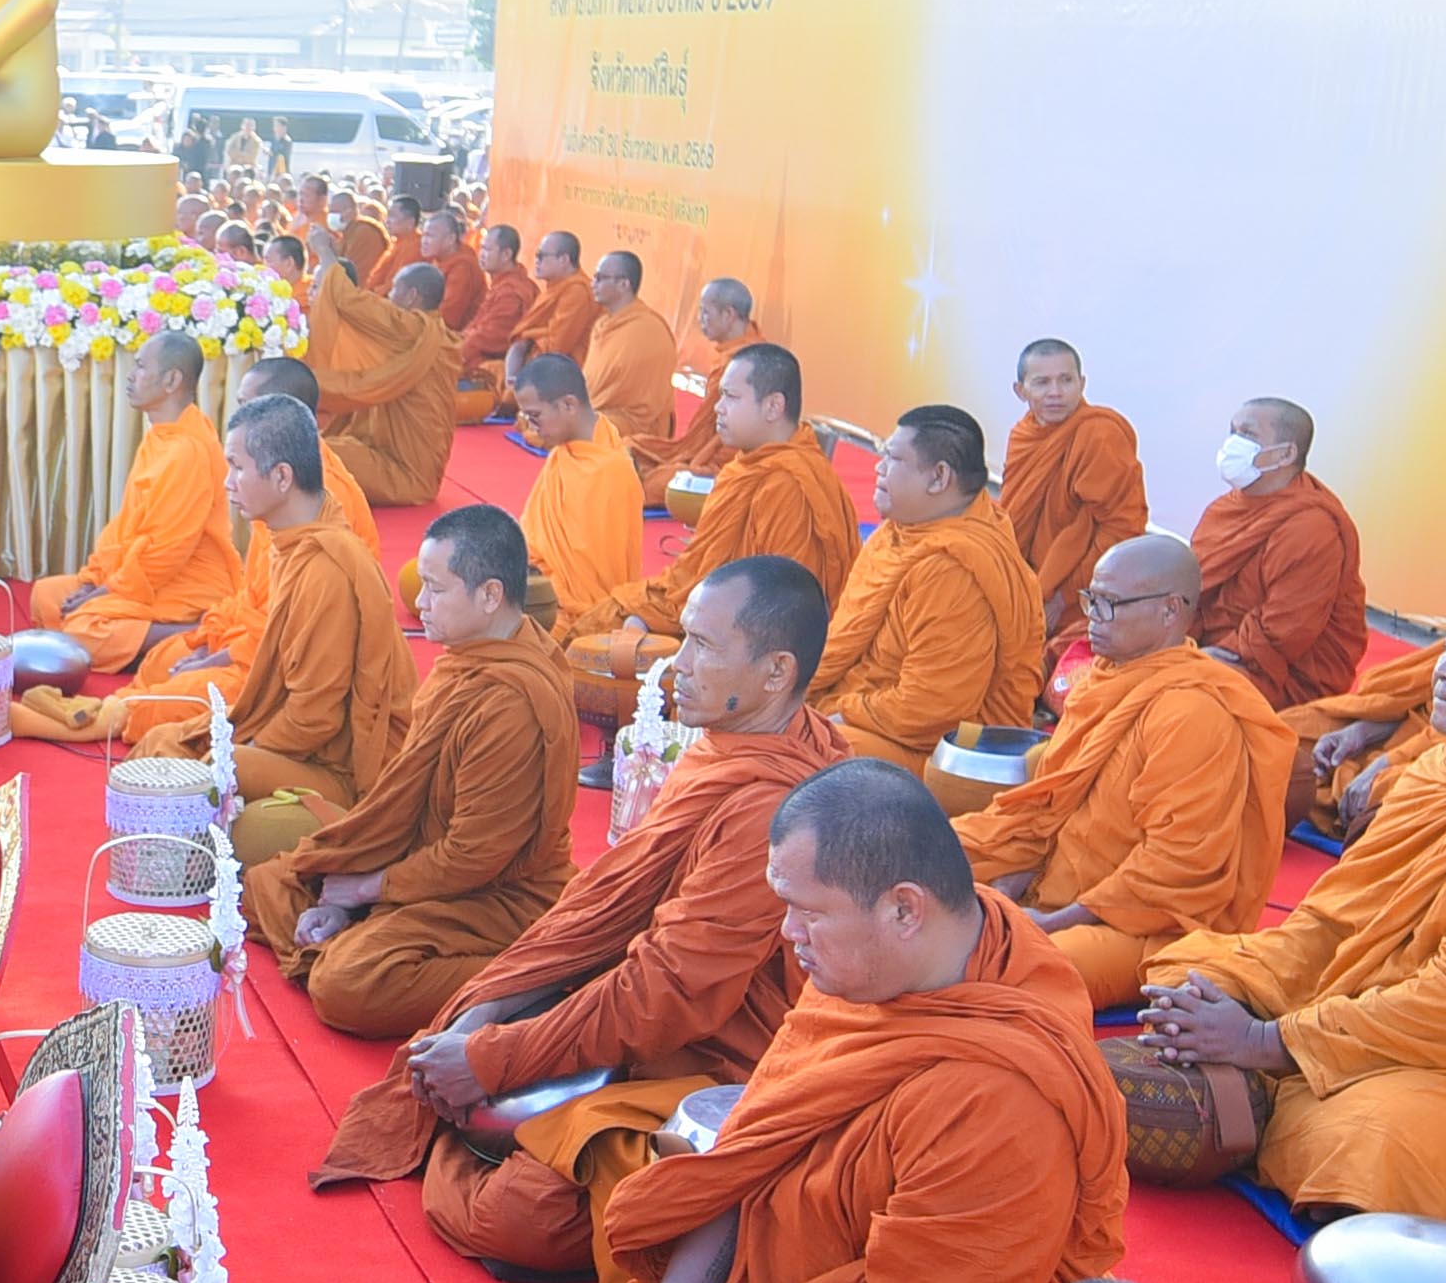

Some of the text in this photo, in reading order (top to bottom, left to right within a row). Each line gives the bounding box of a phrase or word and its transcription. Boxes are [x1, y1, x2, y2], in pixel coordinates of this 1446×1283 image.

[591, 46, 689, 115] จังหวัดกาฬสินธุ์
[684, 140, 715, 169] 2568
